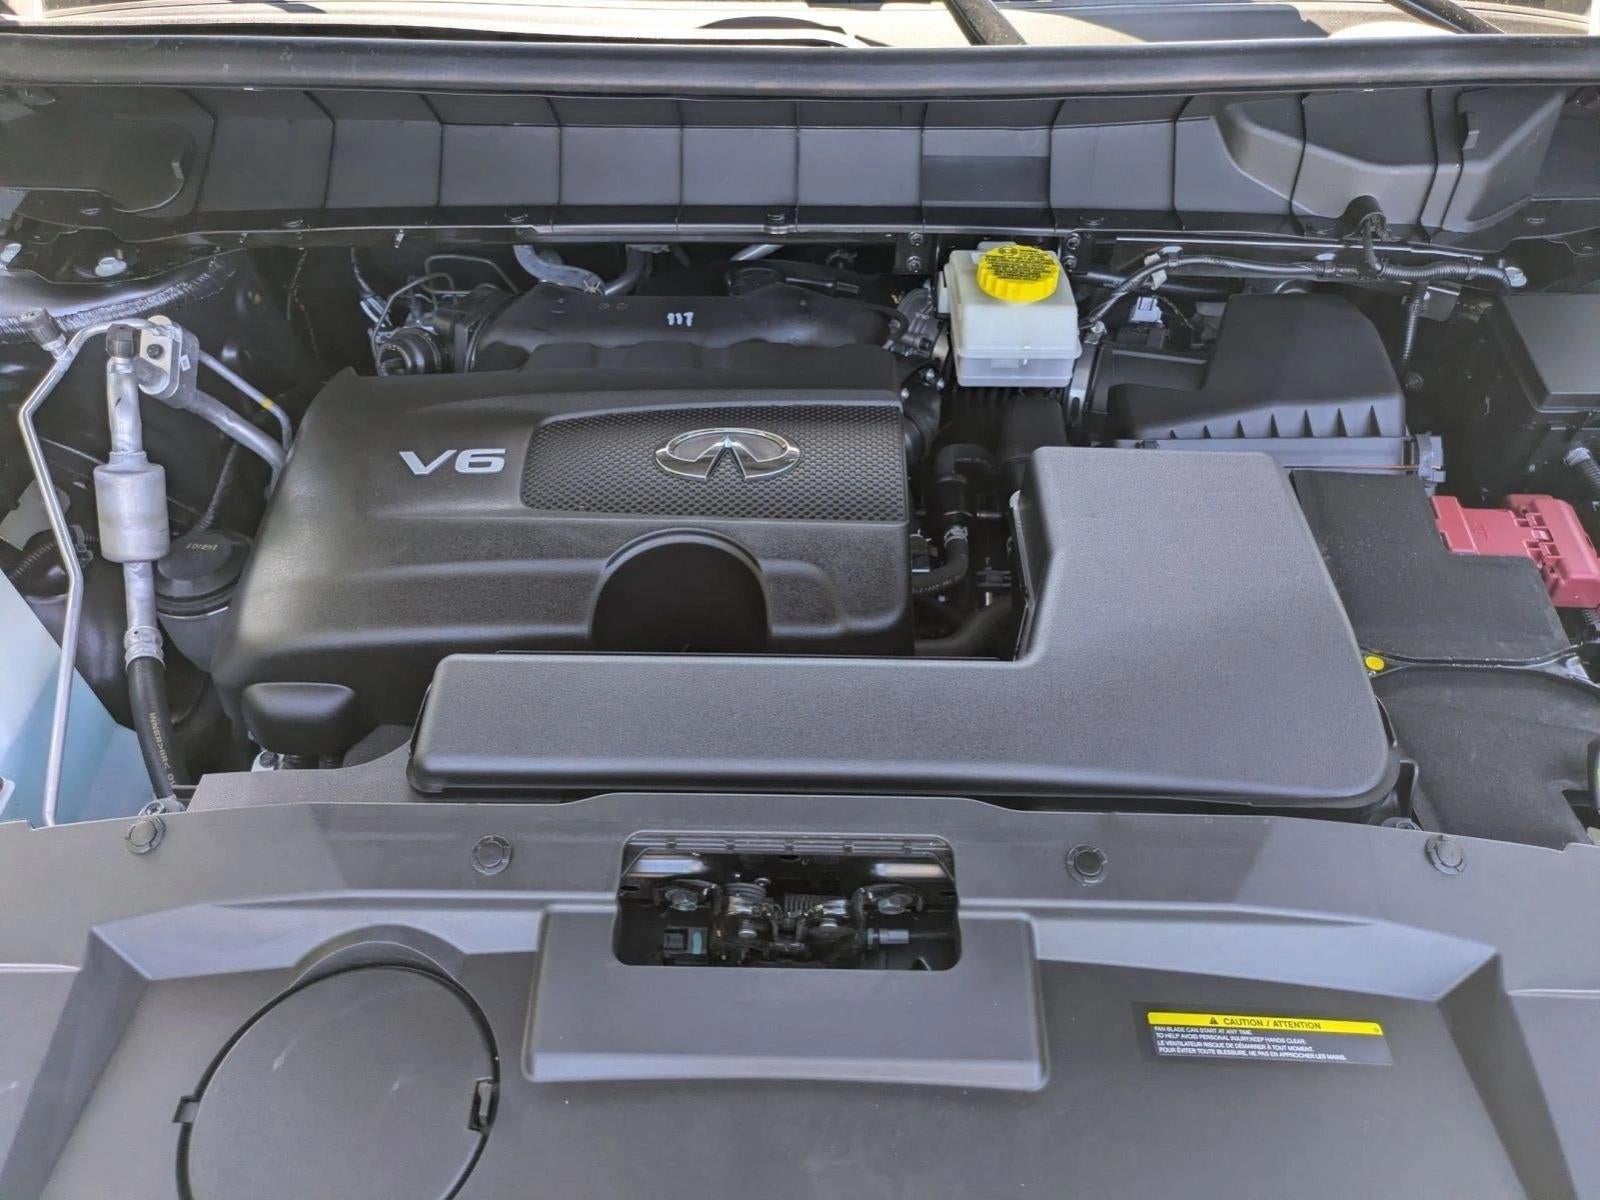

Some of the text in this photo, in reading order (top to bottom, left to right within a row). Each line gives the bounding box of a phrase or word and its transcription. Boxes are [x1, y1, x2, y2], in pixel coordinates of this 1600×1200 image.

[399, 448, 506, 475] V6
[1223, 1017, 1263, 1026] CAUTION
[1273, 1020, 1321, 1029] ATTENTION
